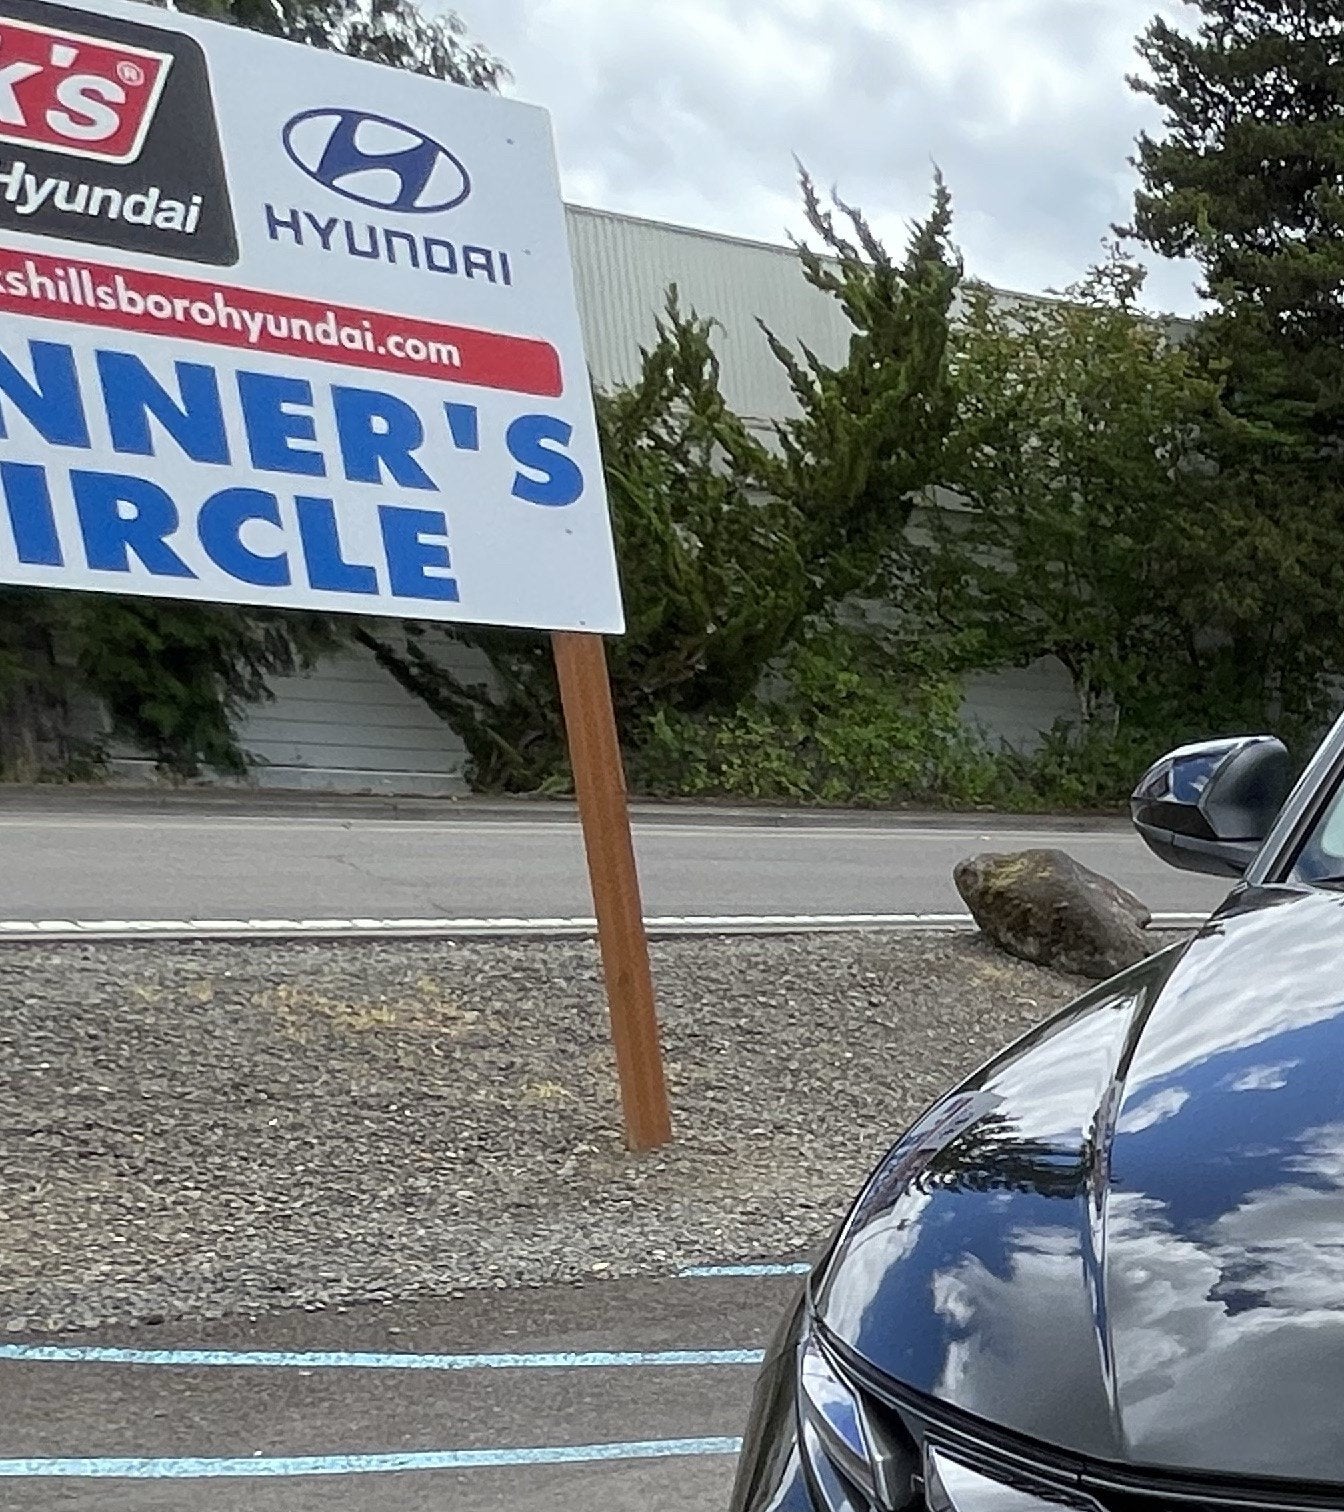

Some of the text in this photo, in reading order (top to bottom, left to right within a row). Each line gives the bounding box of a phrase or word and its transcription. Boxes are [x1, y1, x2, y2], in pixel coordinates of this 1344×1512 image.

[0, 161, 202, 234] Hyundai
[264, 203, 513, 286] HYUNDAI
[0, 260, 461, 368] shillsborohyundai.com
[0, 339, 584, 508] NNER'S
[0, 461, 459, 602] IRCLE
